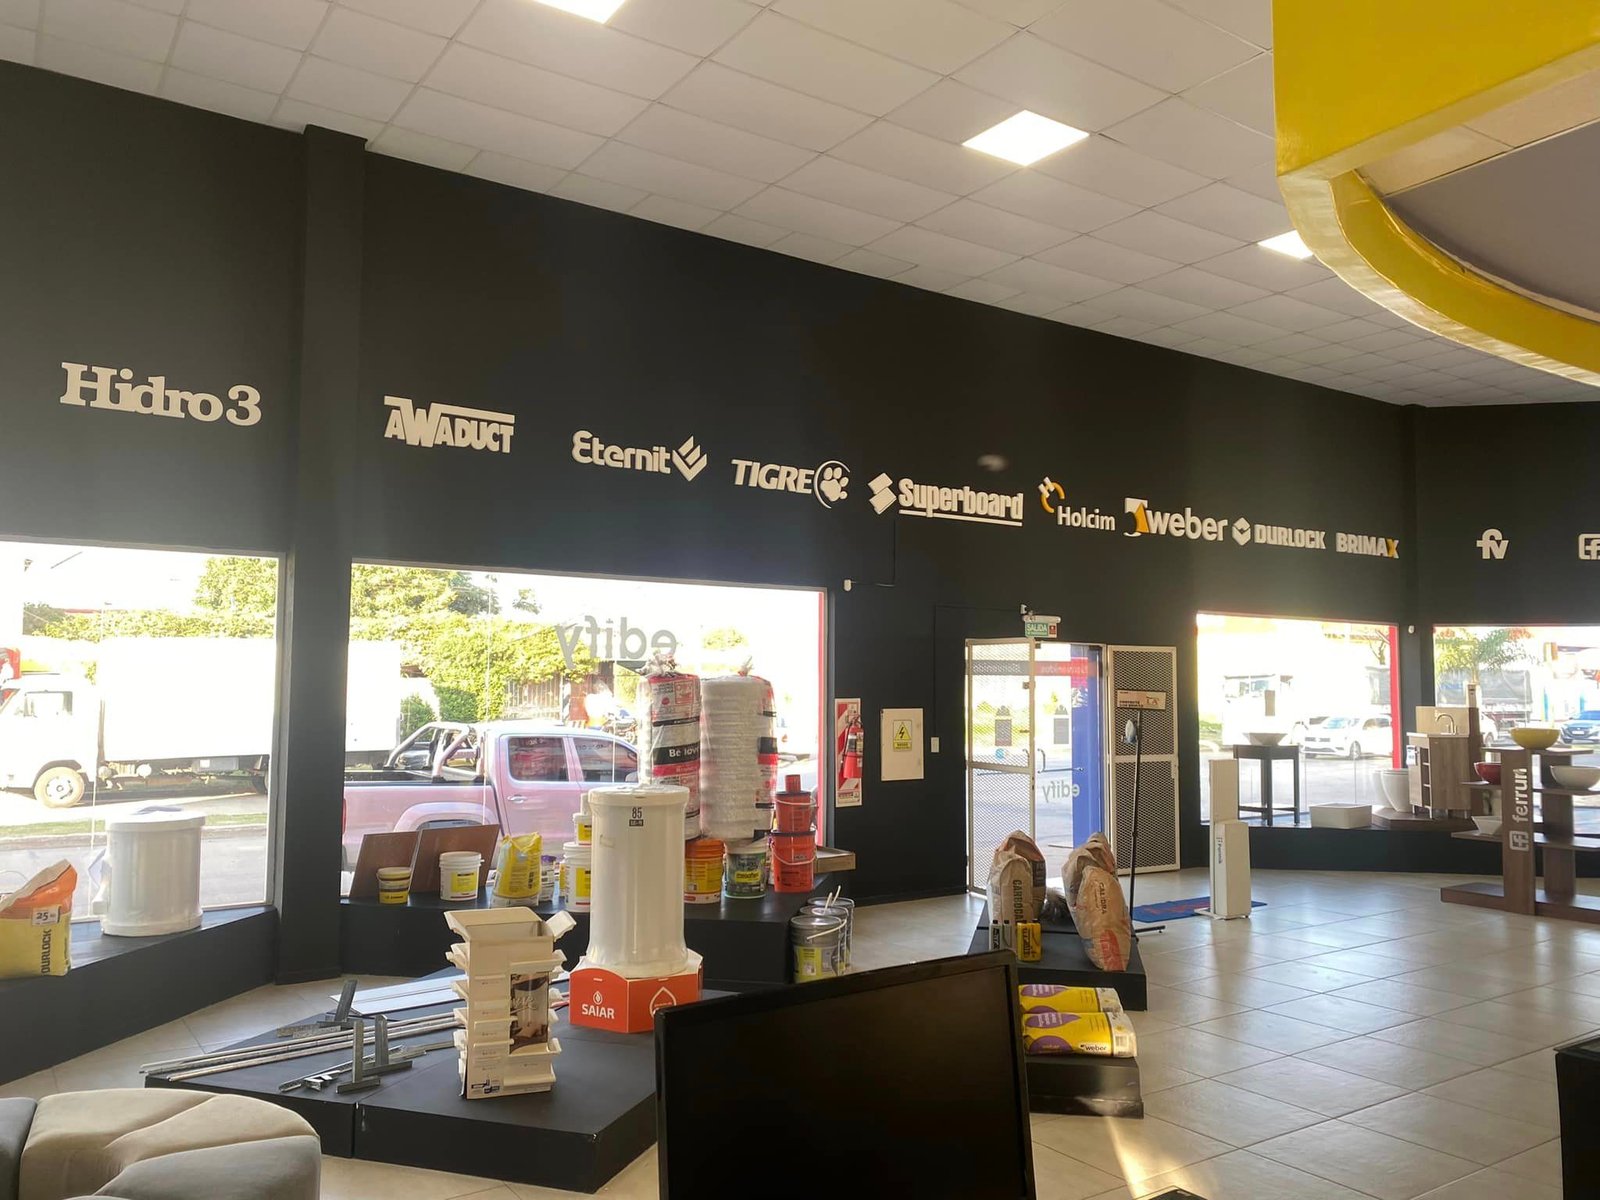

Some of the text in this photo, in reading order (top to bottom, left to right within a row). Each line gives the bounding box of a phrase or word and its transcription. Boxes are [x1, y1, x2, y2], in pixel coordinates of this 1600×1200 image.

[383, 395, 516, 454] AWADUCT
[571, 430, 671, 475] Eternit
[731, 458, 815, 496] TIGRE
[898, 478, 1024, 521] Superboard
[1057, 505, 1116, 532] Holcim
[1147, 507, 1228, 542] weber
[1254, 524, 1326, 550] DURLOCK
[1336, 532, 1400, 560] BRIMAX
[1476, 528, 1509, 560] fv
[1026, 623, 1048, 632] SALIDA
[669, 748, 681, 758] Be
[632, 806, 642, 819] 85
[36, 912, 49, 920] 25
[41, 929, 52, 974] DURLOCK
[581, 1003, 615, 1020] SAIAR
